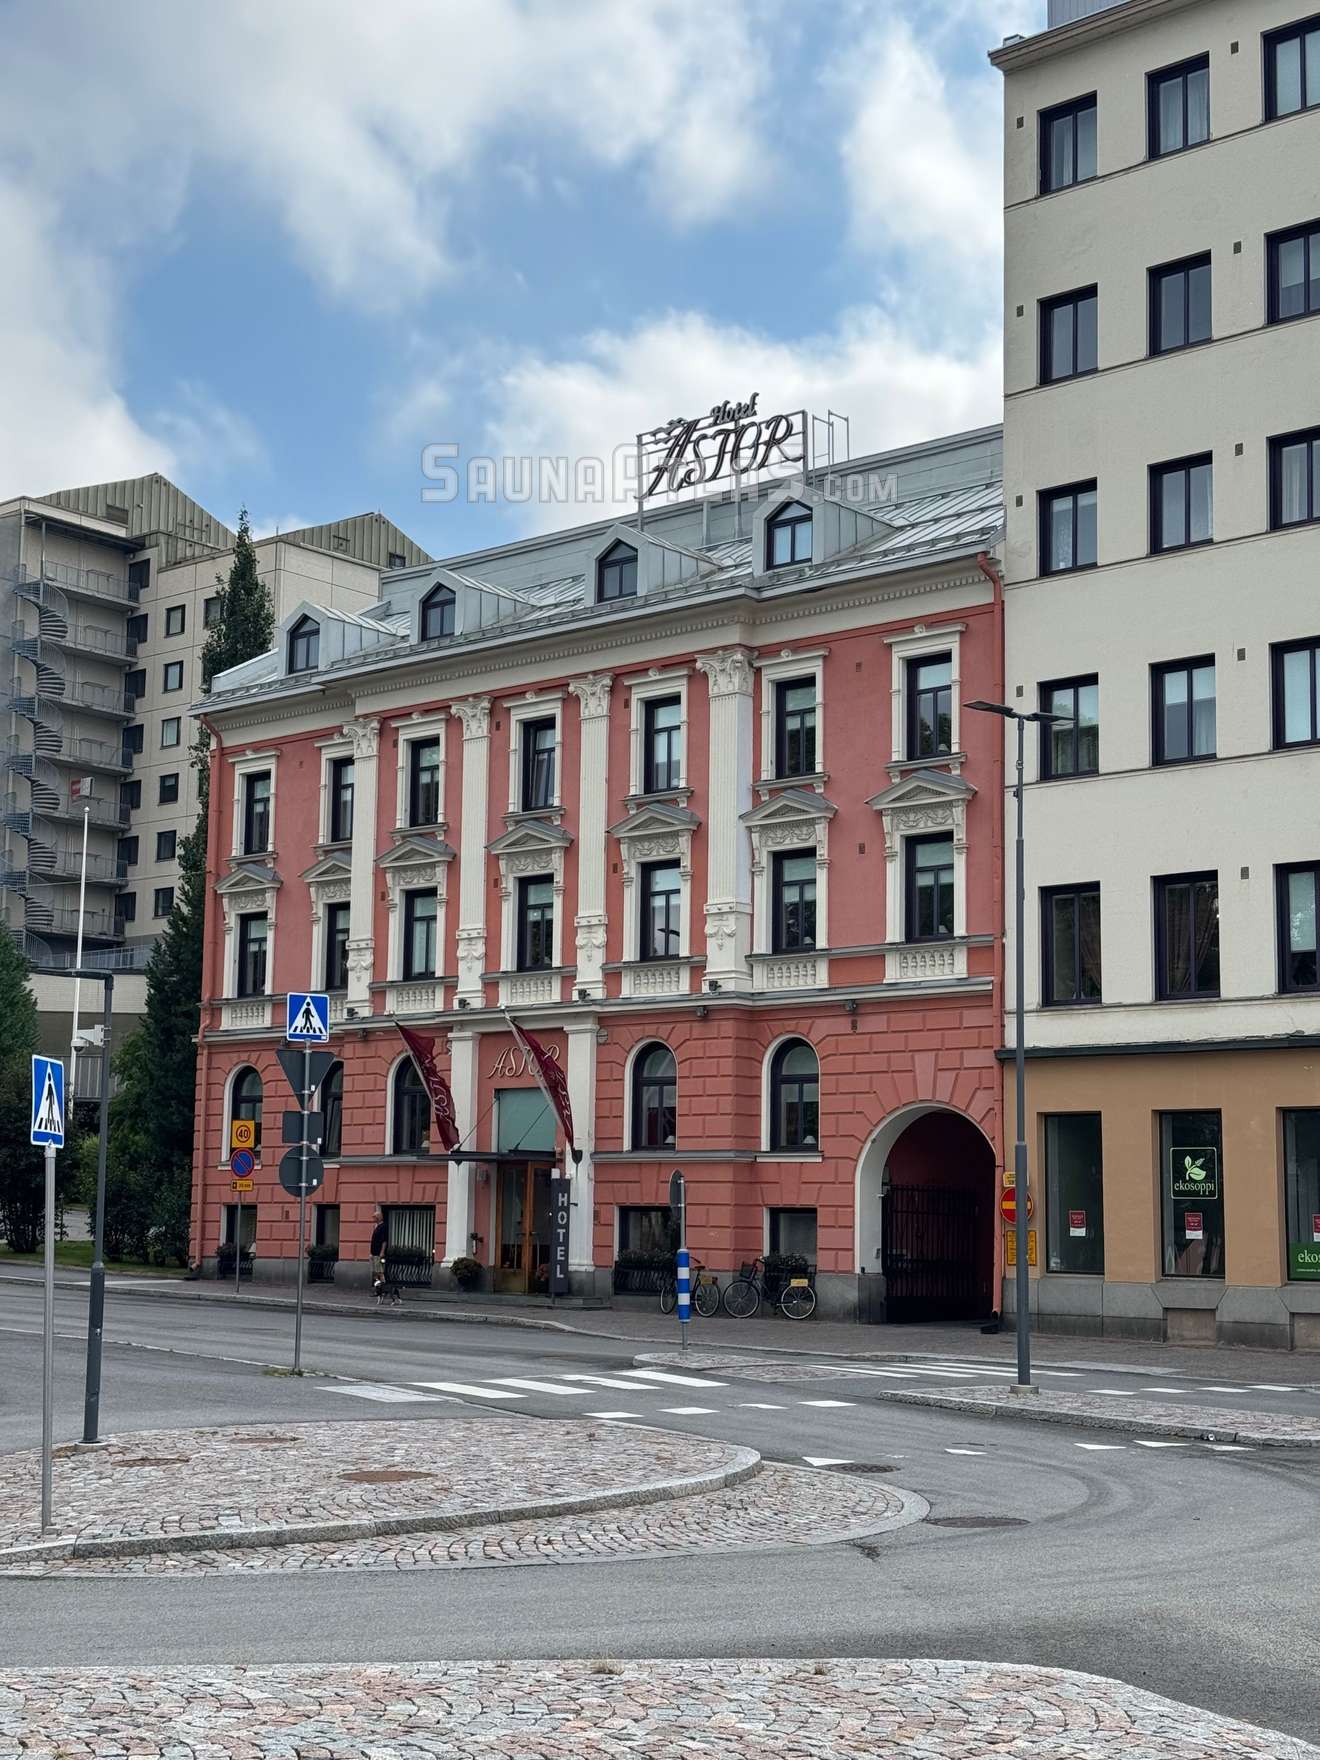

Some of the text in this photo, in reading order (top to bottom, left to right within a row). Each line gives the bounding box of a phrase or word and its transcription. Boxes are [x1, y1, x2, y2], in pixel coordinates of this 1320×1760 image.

[708, 391, 760, 427] Hotel
[633, 414, 807, 500] ASTOR
[238, 1128, 249, 1139] 40
[1174, 1180, 1214, 1194] ekosoppi
[556, 1192, 568, 1278] HOTEL
[1297, 1249, 1320, 1263] eko
